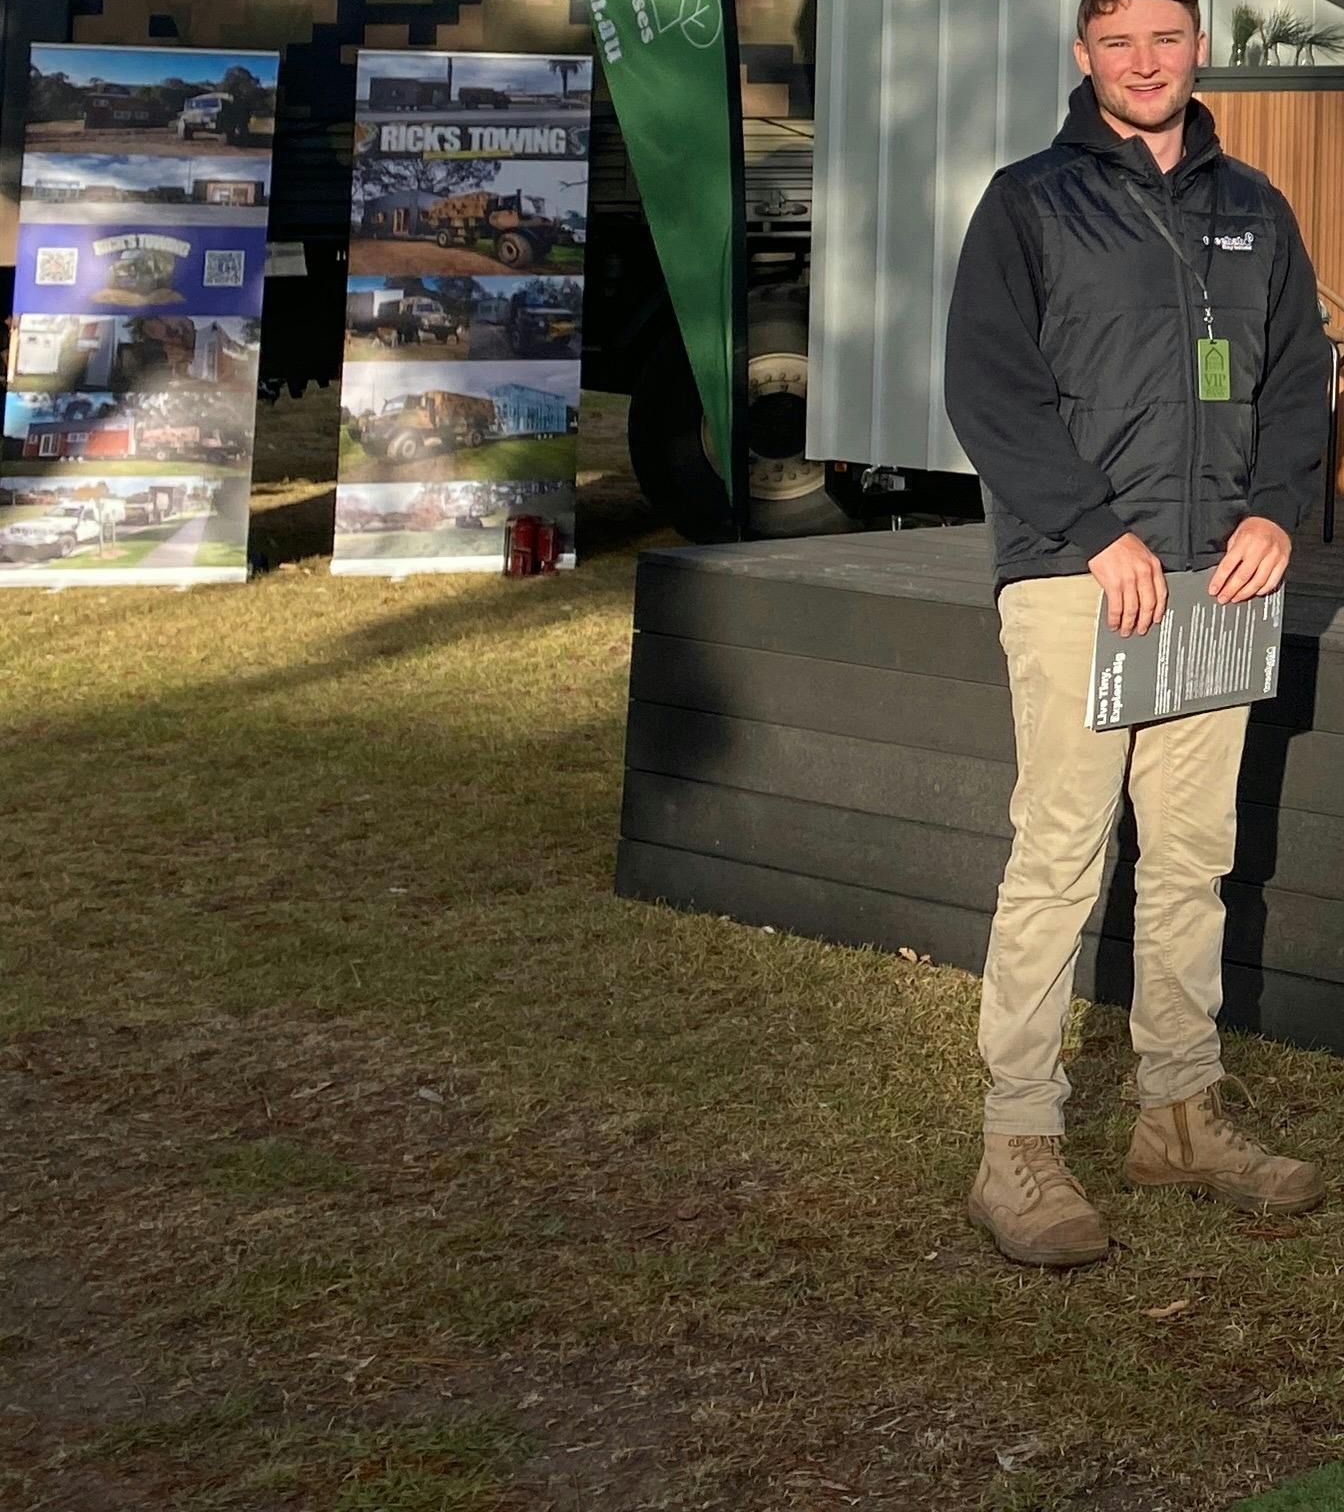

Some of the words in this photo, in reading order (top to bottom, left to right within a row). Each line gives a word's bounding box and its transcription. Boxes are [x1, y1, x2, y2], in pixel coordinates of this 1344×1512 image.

[380, 125, 461, 153] RICK'S
[468, 126, 567, 154] TOWING
[1204, 373, 1226, 388] VIP
